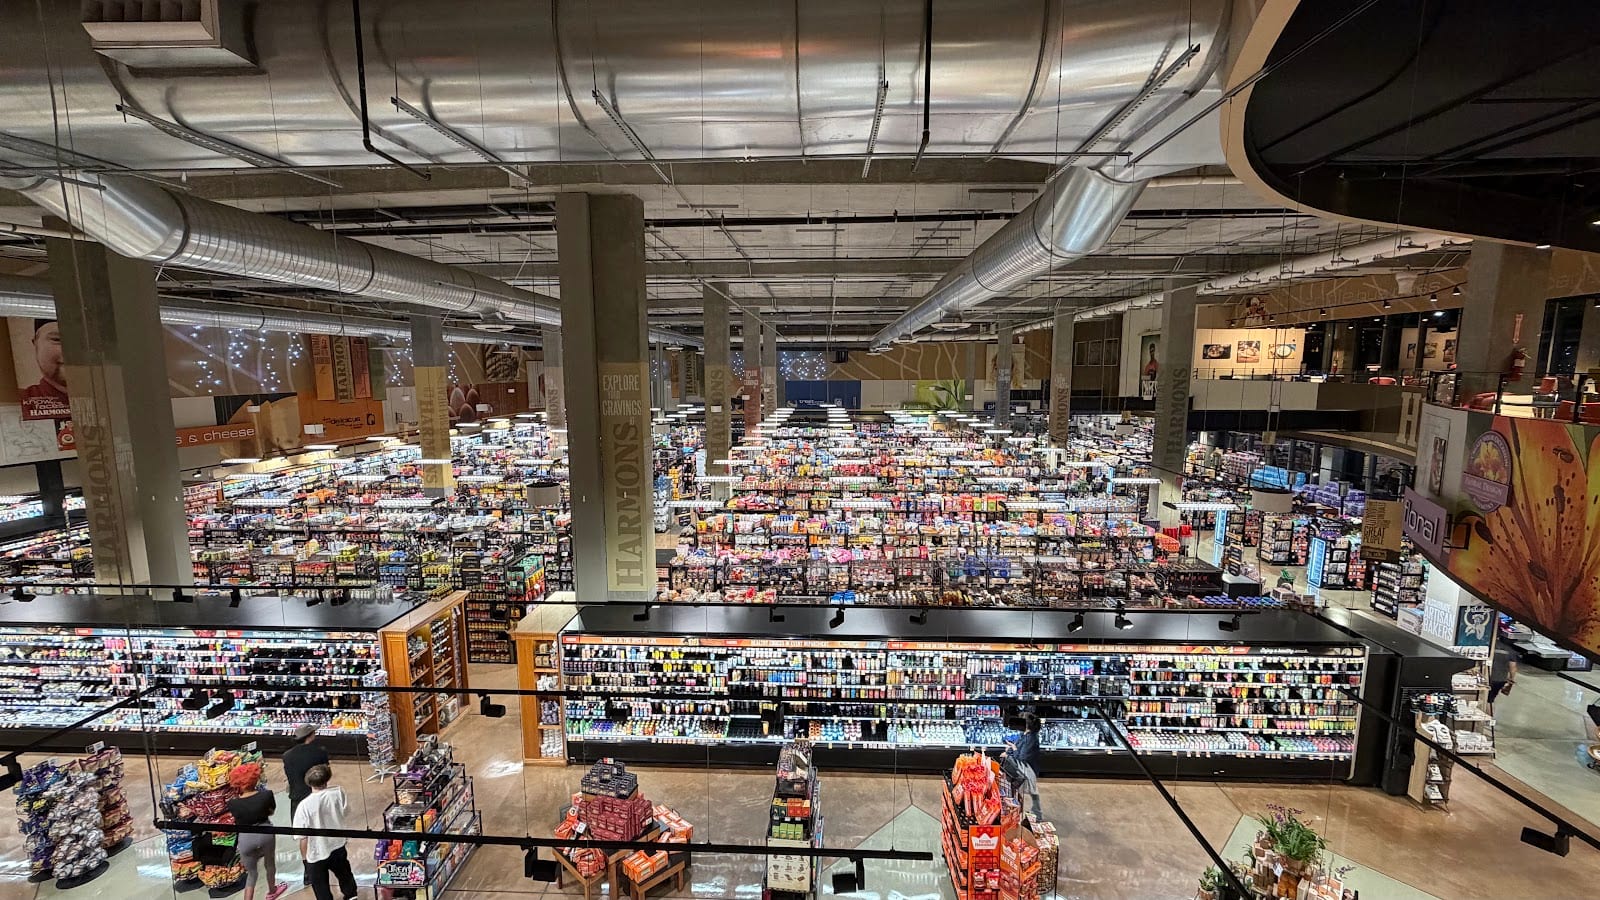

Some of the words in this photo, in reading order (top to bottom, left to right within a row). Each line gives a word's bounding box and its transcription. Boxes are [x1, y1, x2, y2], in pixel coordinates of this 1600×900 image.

[602, 374, 640, 391] EXPLORE
[30, 408, 71, 417] HARMONS
[602, 400, 642, 416] CRAVINGS
[1166, 367, 1189, 453] HARMONS
[1396, 391, 1423, 447] H
[189, 434, 198, 442] &
[203, 427, 255, 441] cheese
[82, 424, 121, 573] HARMONS
[613, 421, 644, 587] HARMONS
[1363, 525, 1386, 539] GREAT
[1404, 499, 1440, 545] floral
[1362, 533, 1385, 546] PEOPLE
[1424, 605, 1456, 629] ARTISAN
[1423, 618, 1453, 642] BAKERS
